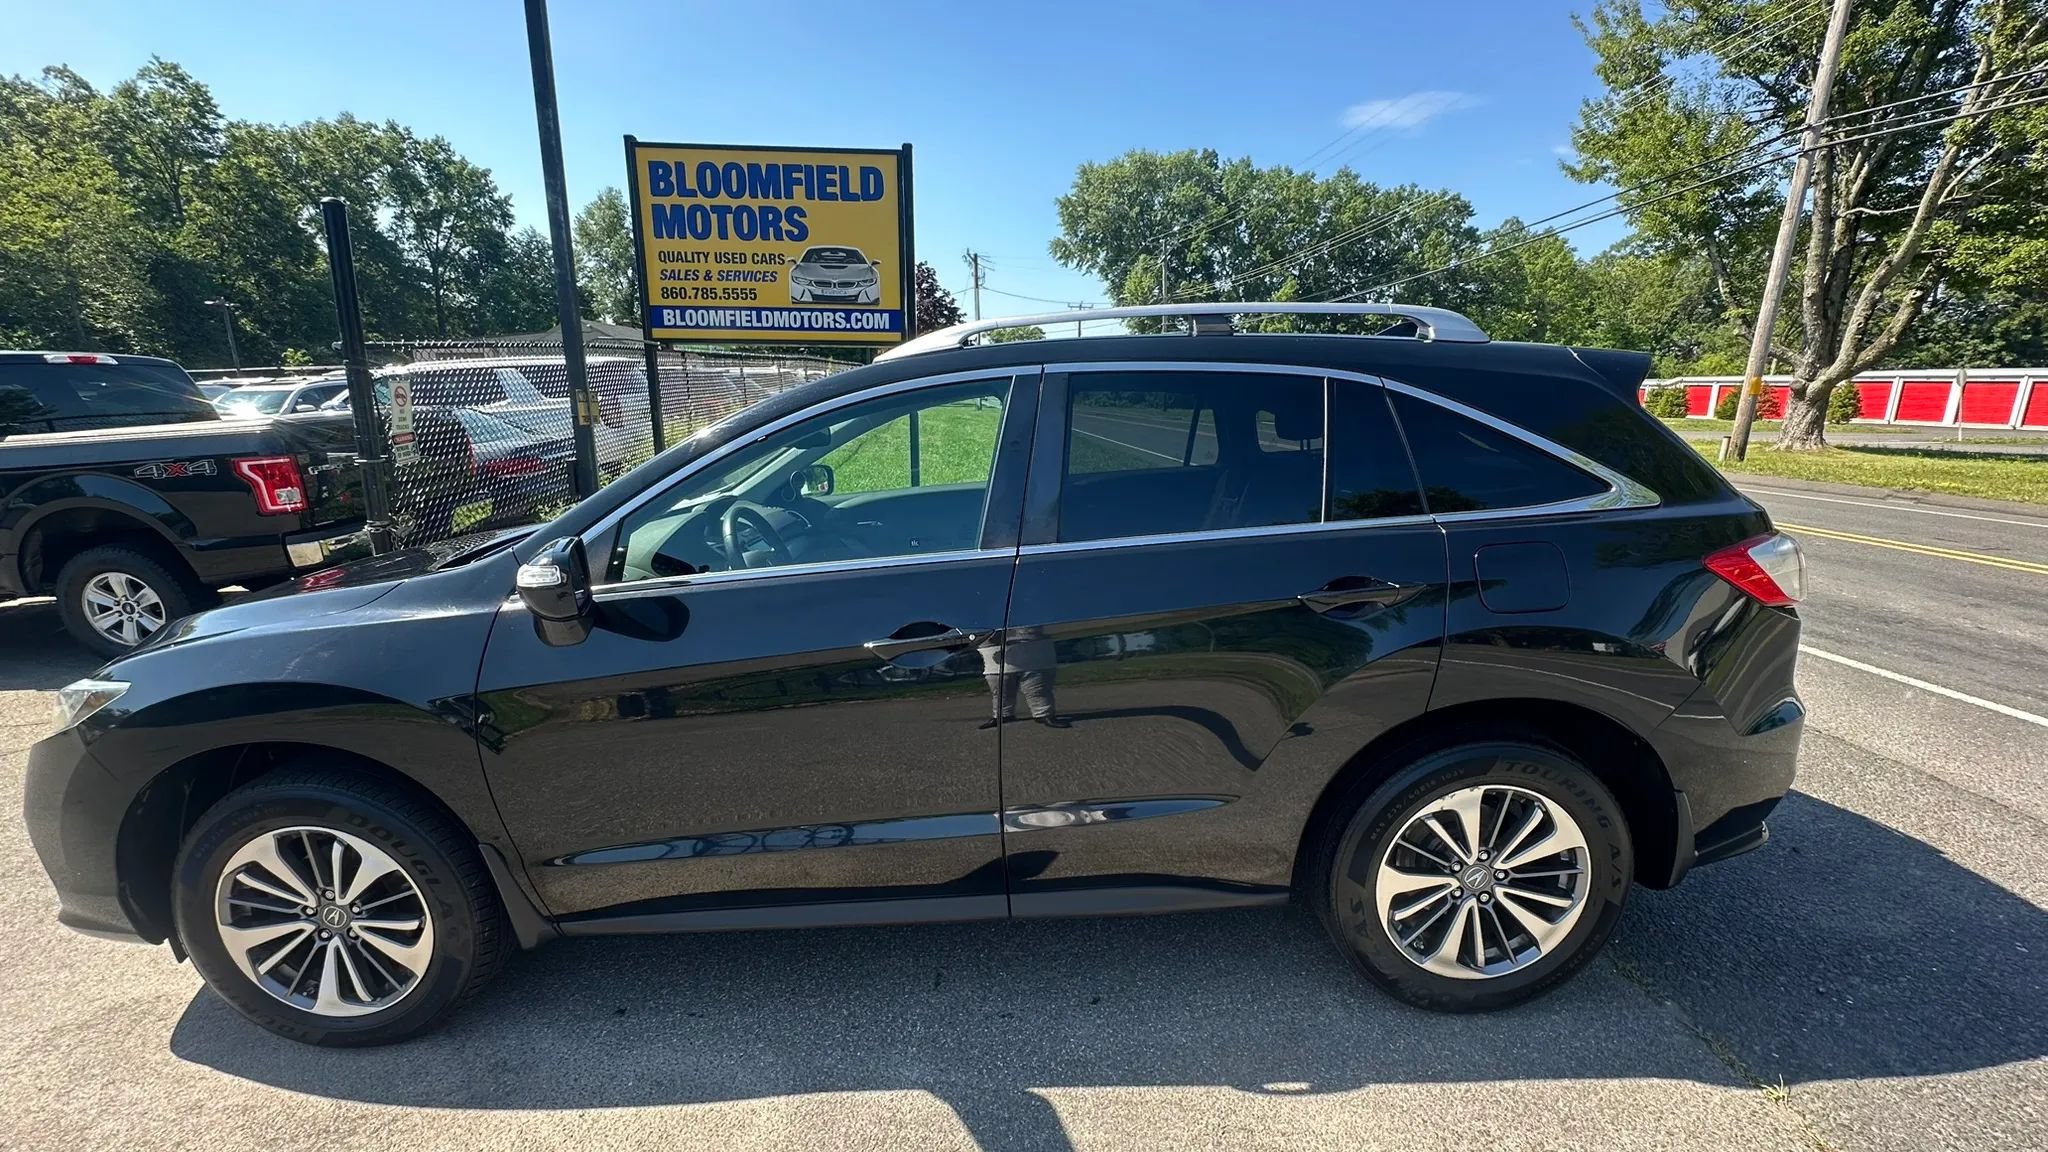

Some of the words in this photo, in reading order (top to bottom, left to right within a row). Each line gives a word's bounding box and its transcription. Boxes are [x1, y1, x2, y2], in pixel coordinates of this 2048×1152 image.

[648, 160, 885, 202] BLOOMFIELD
[650, 203, 809, 242] MOTORS
[658, 251, 710, 265] QUALITY
[714, 251, 747, 265] USED
[751, 252, 785, 266] CARS
[659, 269, 700, 282] SALES
[703, 269, 713, 282] &
[717, 270, 778, 283] SERVICES
[660, 287, 758, 301] 860.785.5555
[663, 309, 890, 330] BLOOMFIELDMOTORS.COM
[1504, 758, 1610, 829] TOURING
